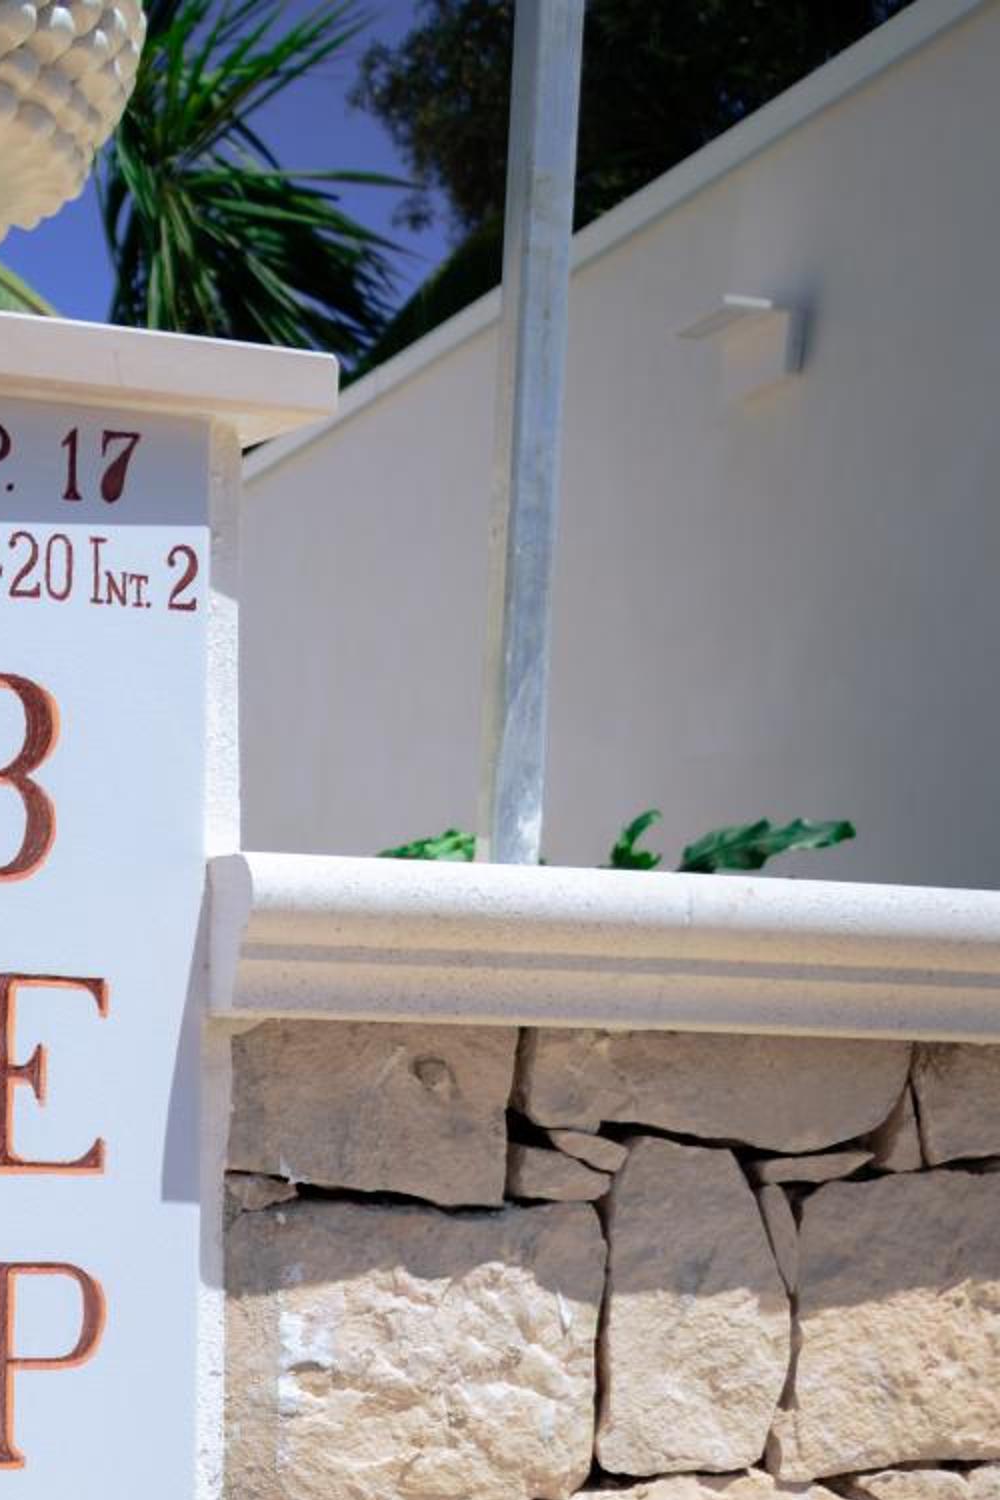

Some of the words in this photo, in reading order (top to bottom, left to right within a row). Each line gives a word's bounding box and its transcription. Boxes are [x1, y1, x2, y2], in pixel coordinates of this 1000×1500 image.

[61, 426, 141, 504] 17
[89, 535, 151, 609] INT.
[166, 544, 199, 611] 2
